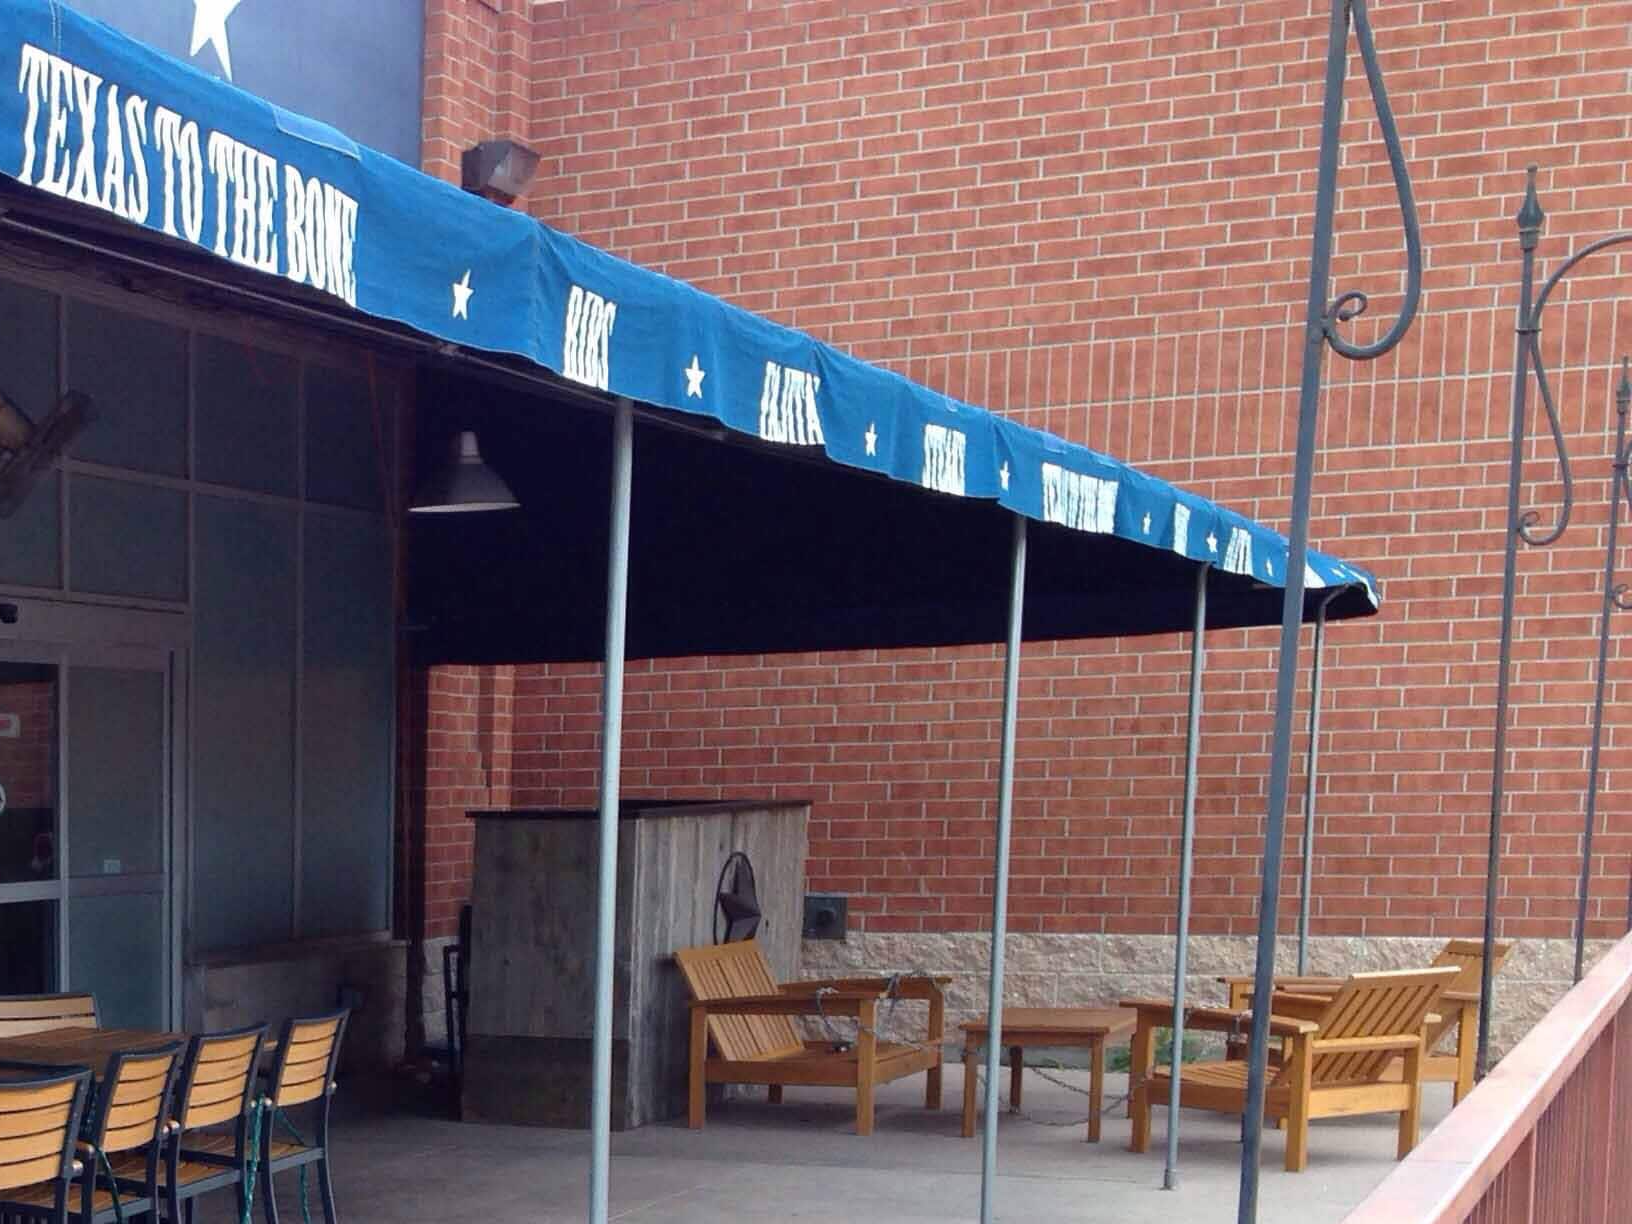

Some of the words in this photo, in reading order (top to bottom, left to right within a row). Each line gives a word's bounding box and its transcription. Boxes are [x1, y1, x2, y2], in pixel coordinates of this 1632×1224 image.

[18, 43, 149, 225] TEXAS
[154, 106, 203, 244] TO
[208, 129, 278, 275] THE
[285, 164, 358, 307] BONE
